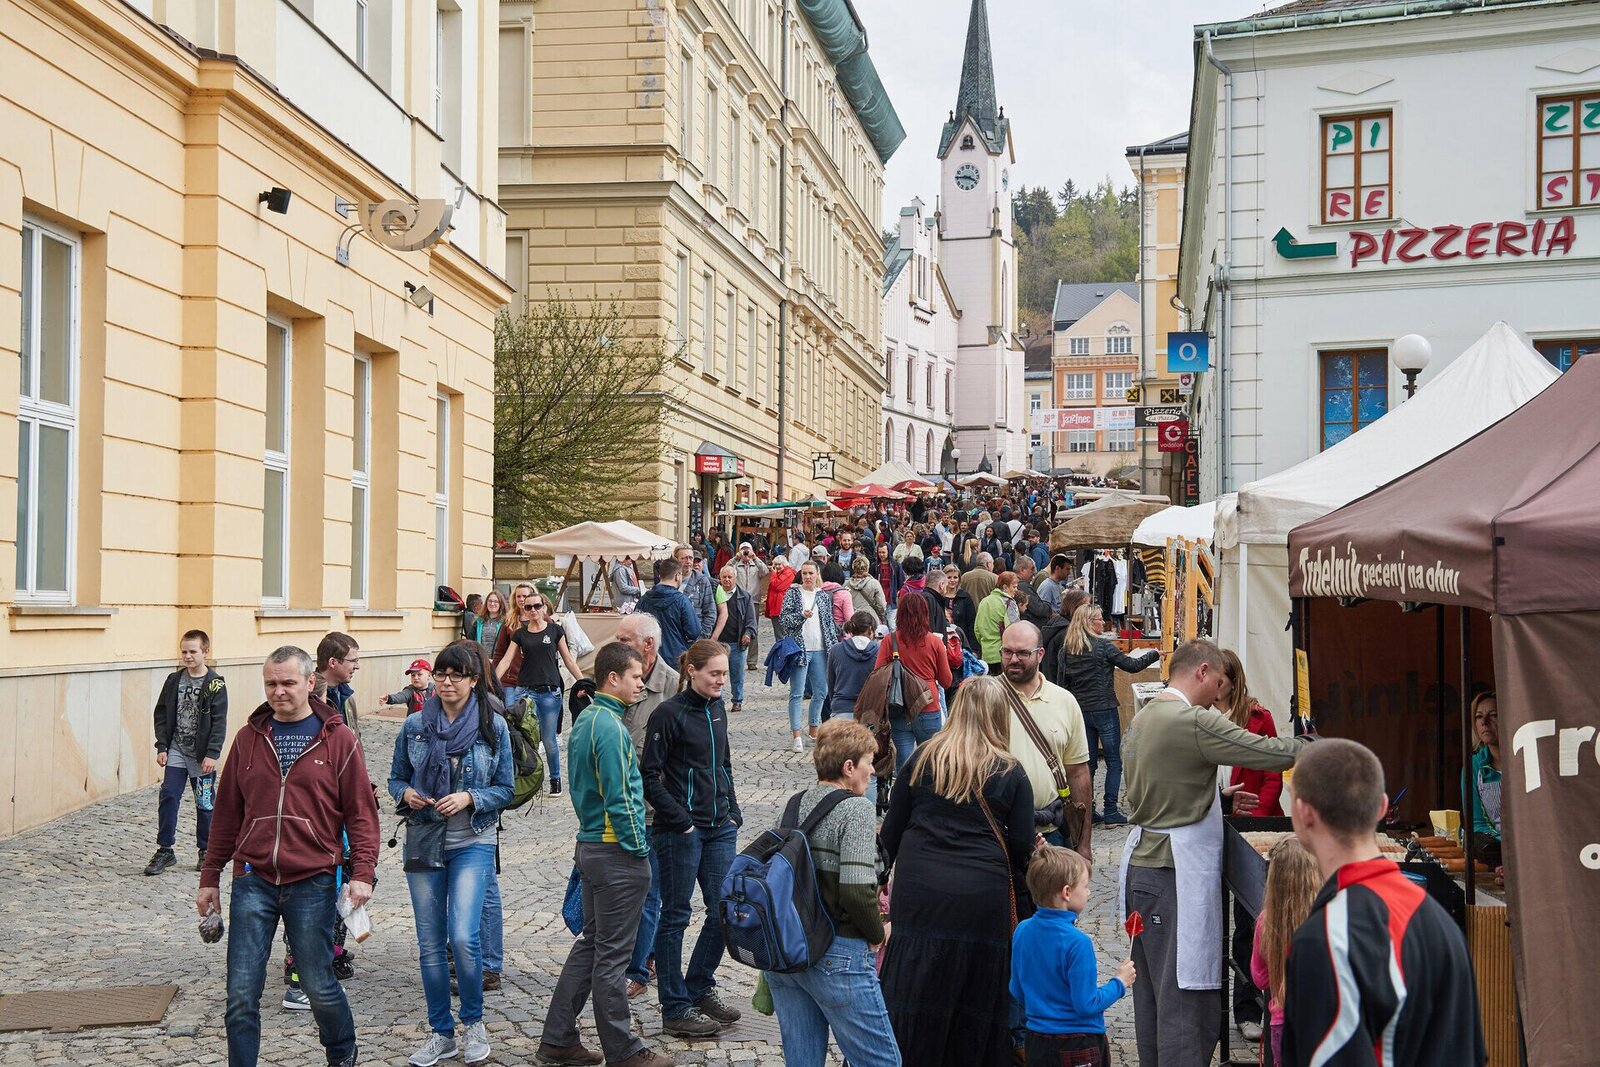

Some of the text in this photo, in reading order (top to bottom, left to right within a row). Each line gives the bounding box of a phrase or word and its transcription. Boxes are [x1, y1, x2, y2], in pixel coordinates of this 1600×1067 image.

[1349, 215, 1577, 268] PIZZERIA
[1143, 407, 1182, 416] Pizzeria
[1159, 441, 1184, 449] vodafon
[1184, 440, 1198, 497] CAFE
[1299, 541, 1365, 598] Trdelník
[1362, 549, 1406, 595] pečený
[1407, 564, 1425, 590] na
[1512, 719, 1600, 793] Tr
